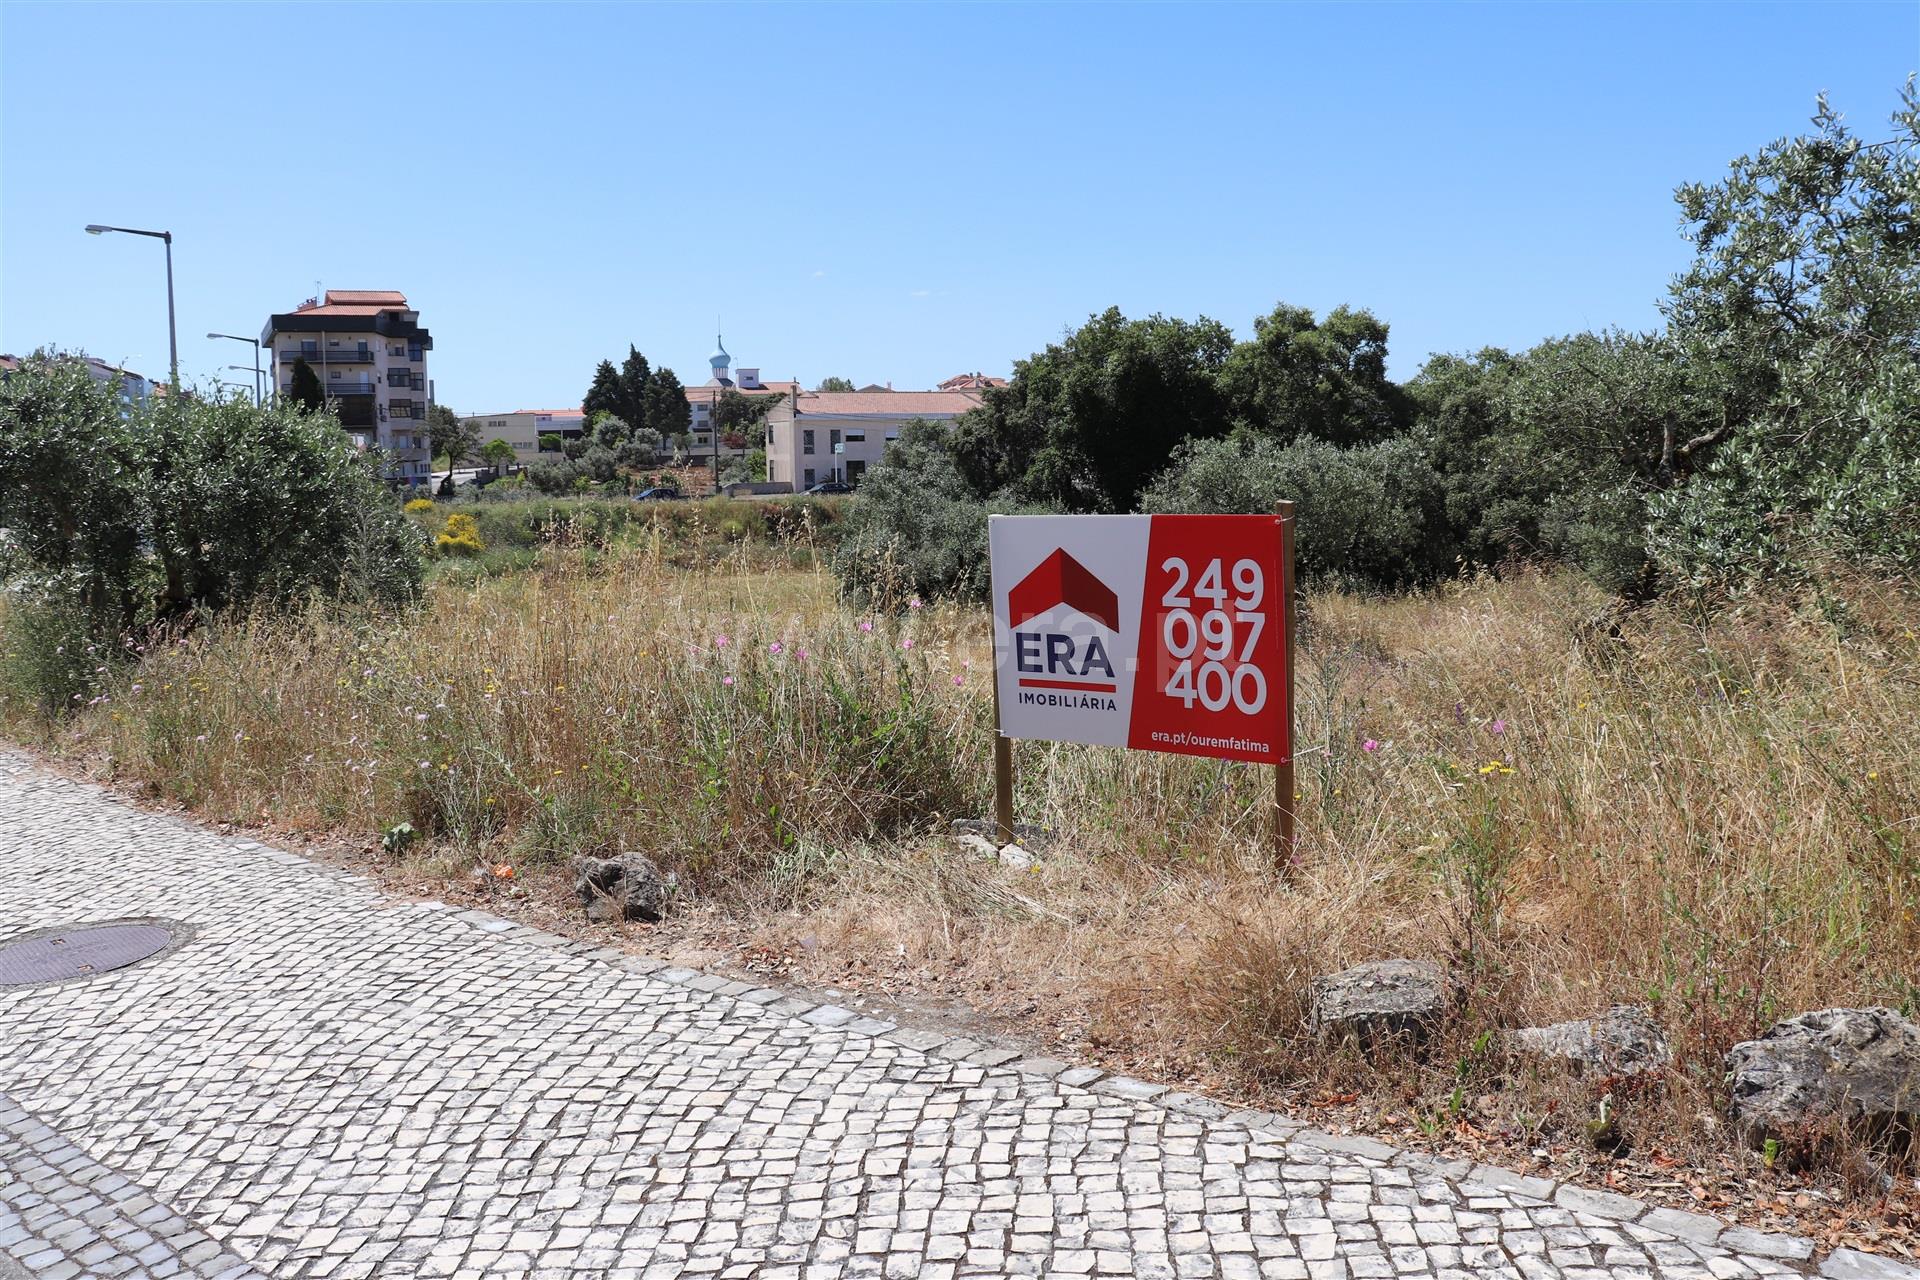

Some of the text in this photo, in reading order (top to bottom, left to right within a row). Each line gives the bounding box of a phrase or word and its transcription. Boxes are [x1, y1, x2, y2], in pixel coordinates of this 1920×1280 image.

[1161, 556, 1264, 611] 249
[1015, 632, 1116, 678] ERA
[1163, 608, 1266, 662] 097
[1018, 692, 1117, 712] IMOBILIÁRIA
[1164, 659, 1268, 715] 400
[1151, 730, 1270, 753] era.pt/ouremfatima
